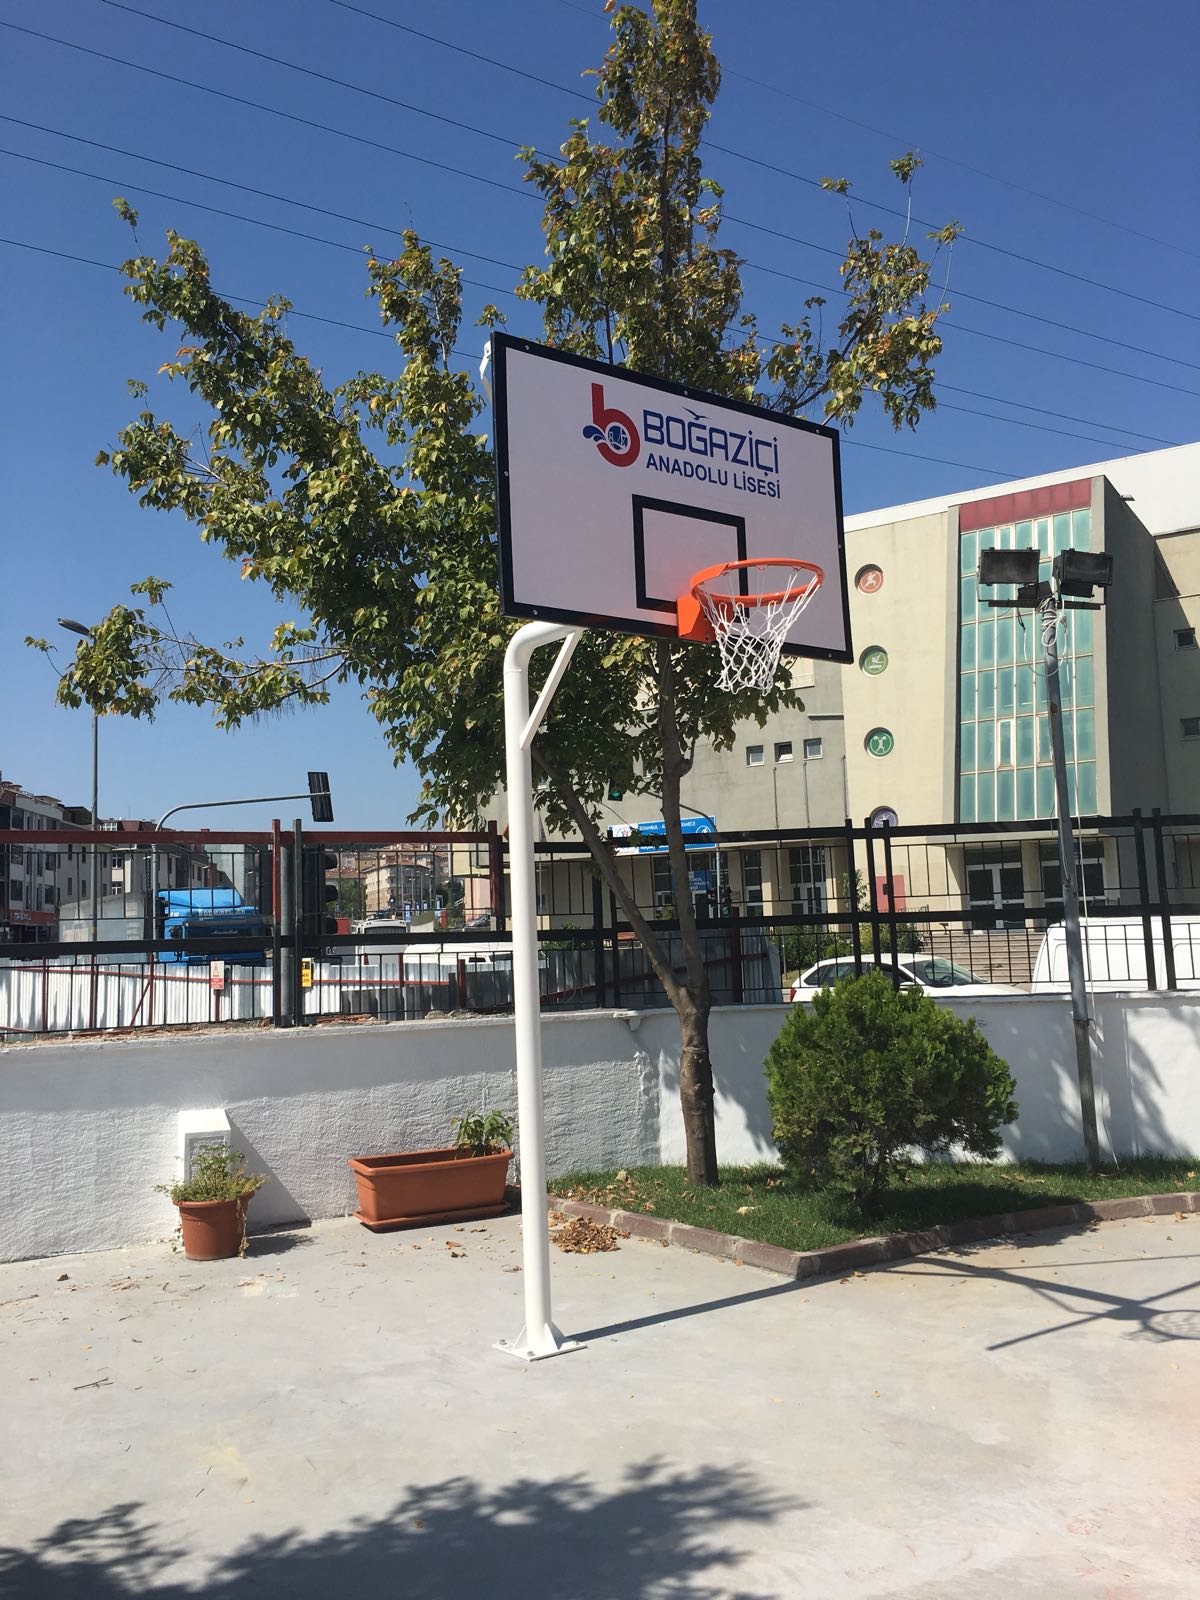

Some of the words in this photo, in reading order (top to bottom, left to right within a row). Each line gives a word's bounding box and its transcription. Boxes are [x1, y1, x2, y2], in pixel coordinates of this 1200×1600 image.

[643, 407, 779, 477] BOĞAZİÇİ
[646, 453, 728, 486] ANADOLU
[733, 470, 781, 499] LİSESİ
